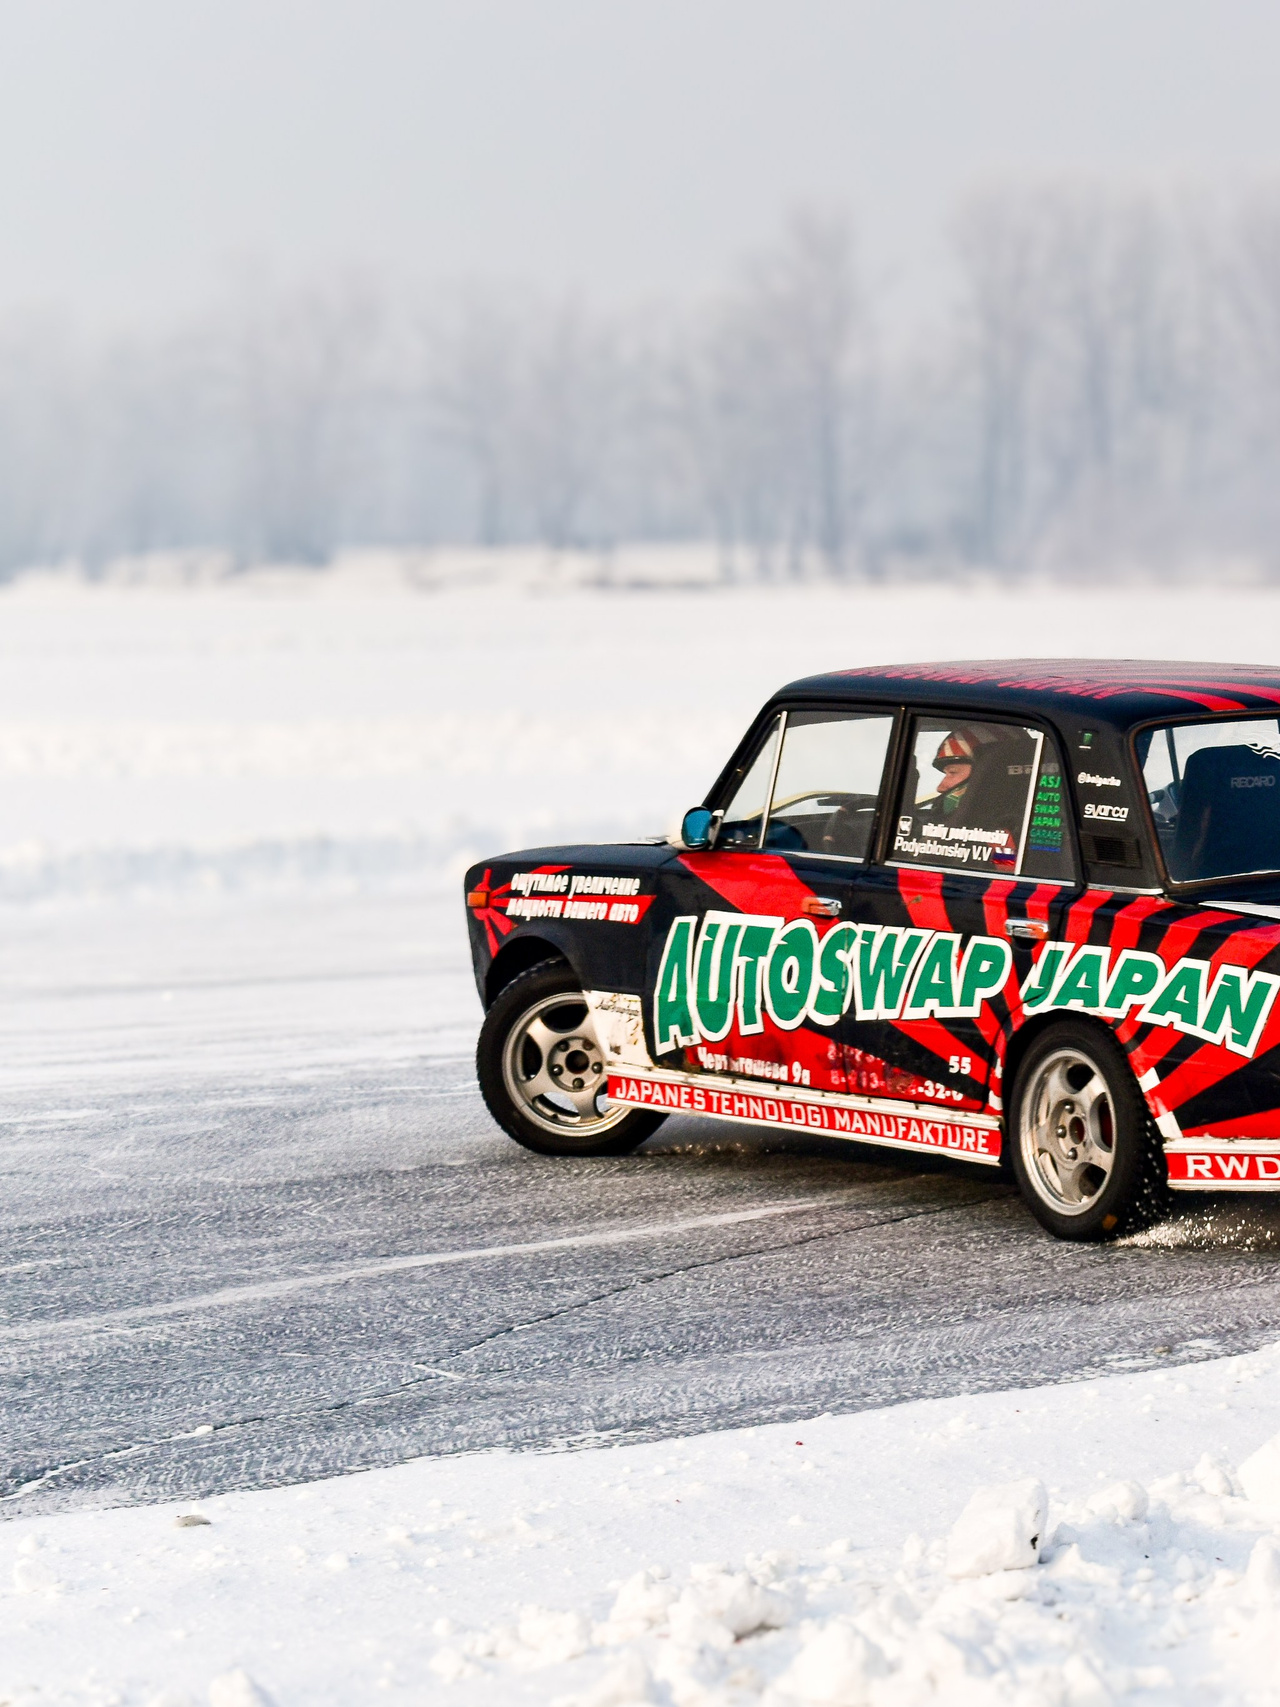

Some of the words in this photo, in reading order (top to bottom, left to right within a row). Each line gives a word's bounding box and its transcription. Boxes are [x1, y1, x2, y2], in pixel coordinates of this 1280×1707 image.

[1040, 775, 1062, 788] ASJ
[1230, 775, 1276, 788] RECARO
[1036, 792, 1061, 802] AUTO
[1034, 804, 1060, 815] SWAP
[1032, 816, 1061, 828] JAPAN
[1030, 828, 1062, 841] GARAGE
[894, 836, 971, 863] Podyablonskiy
[567, 875, 641, 900] увеличение
[563, 900, 608, 921] вашего
[608, 903, 639, 923] авто
[654, 911, 1012, 1056] AUTOSWAP
[615, 1077, 708, 1109] JAPANES
[706, 1090, 829, 1127] TEHNOLOGI
[833, 1113, 991, 1154] MANUFAKTURE
